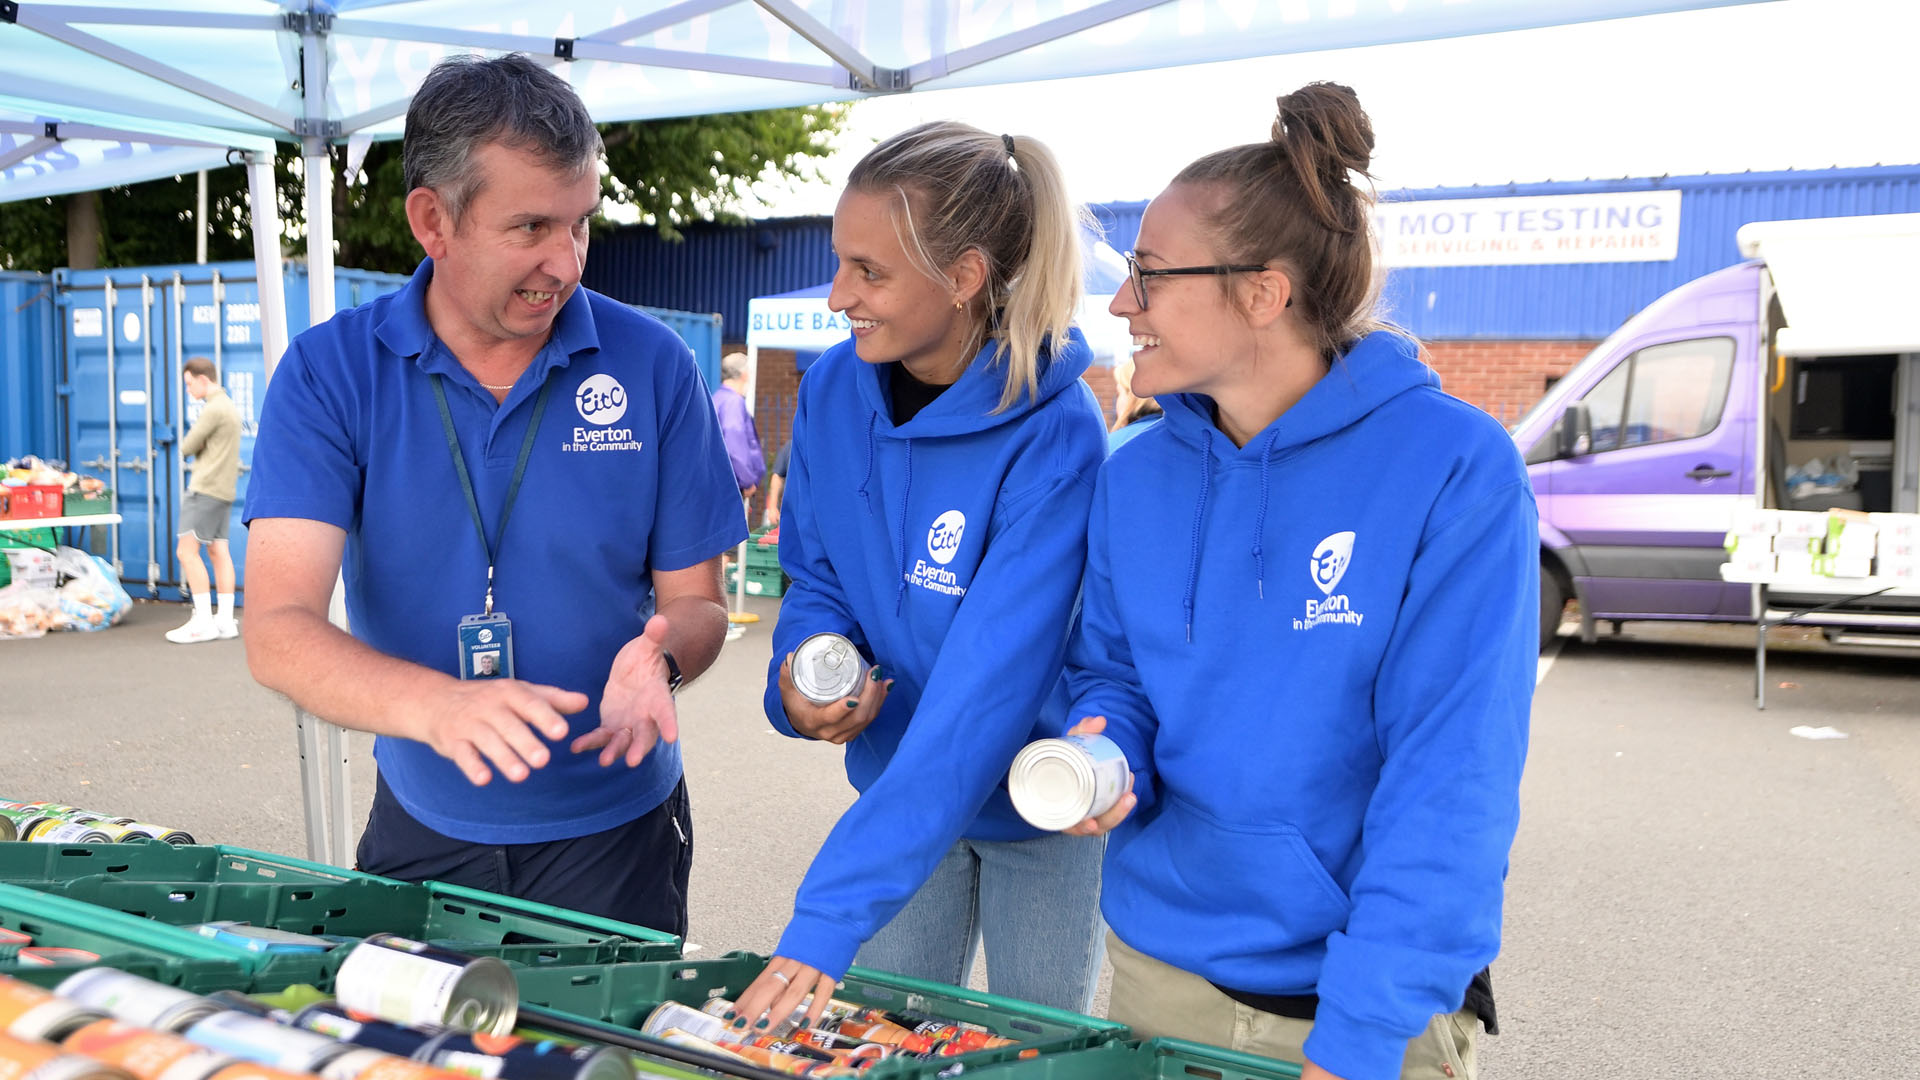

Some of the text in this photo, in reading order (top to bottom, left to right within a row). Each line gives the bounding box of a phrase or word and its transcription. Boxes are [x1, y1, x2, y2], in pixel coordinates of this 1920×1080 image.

[1399, 211, 1478, 235] MOT
[1494, 204, 1663, 232] TESTING
[1398, 234, 1660, 254] SERVICING & REPAIRS
[753, 312, 805, 331] BLUE
[573, 426, 632, 442] Everton
[562, 440, 642, 452] in the Community
[913, 559, 957, 586] Everton
[910, 573, 923, 587] the
[923, 578, 967, 598] Community
[1292, 617, 1304, 631] in
